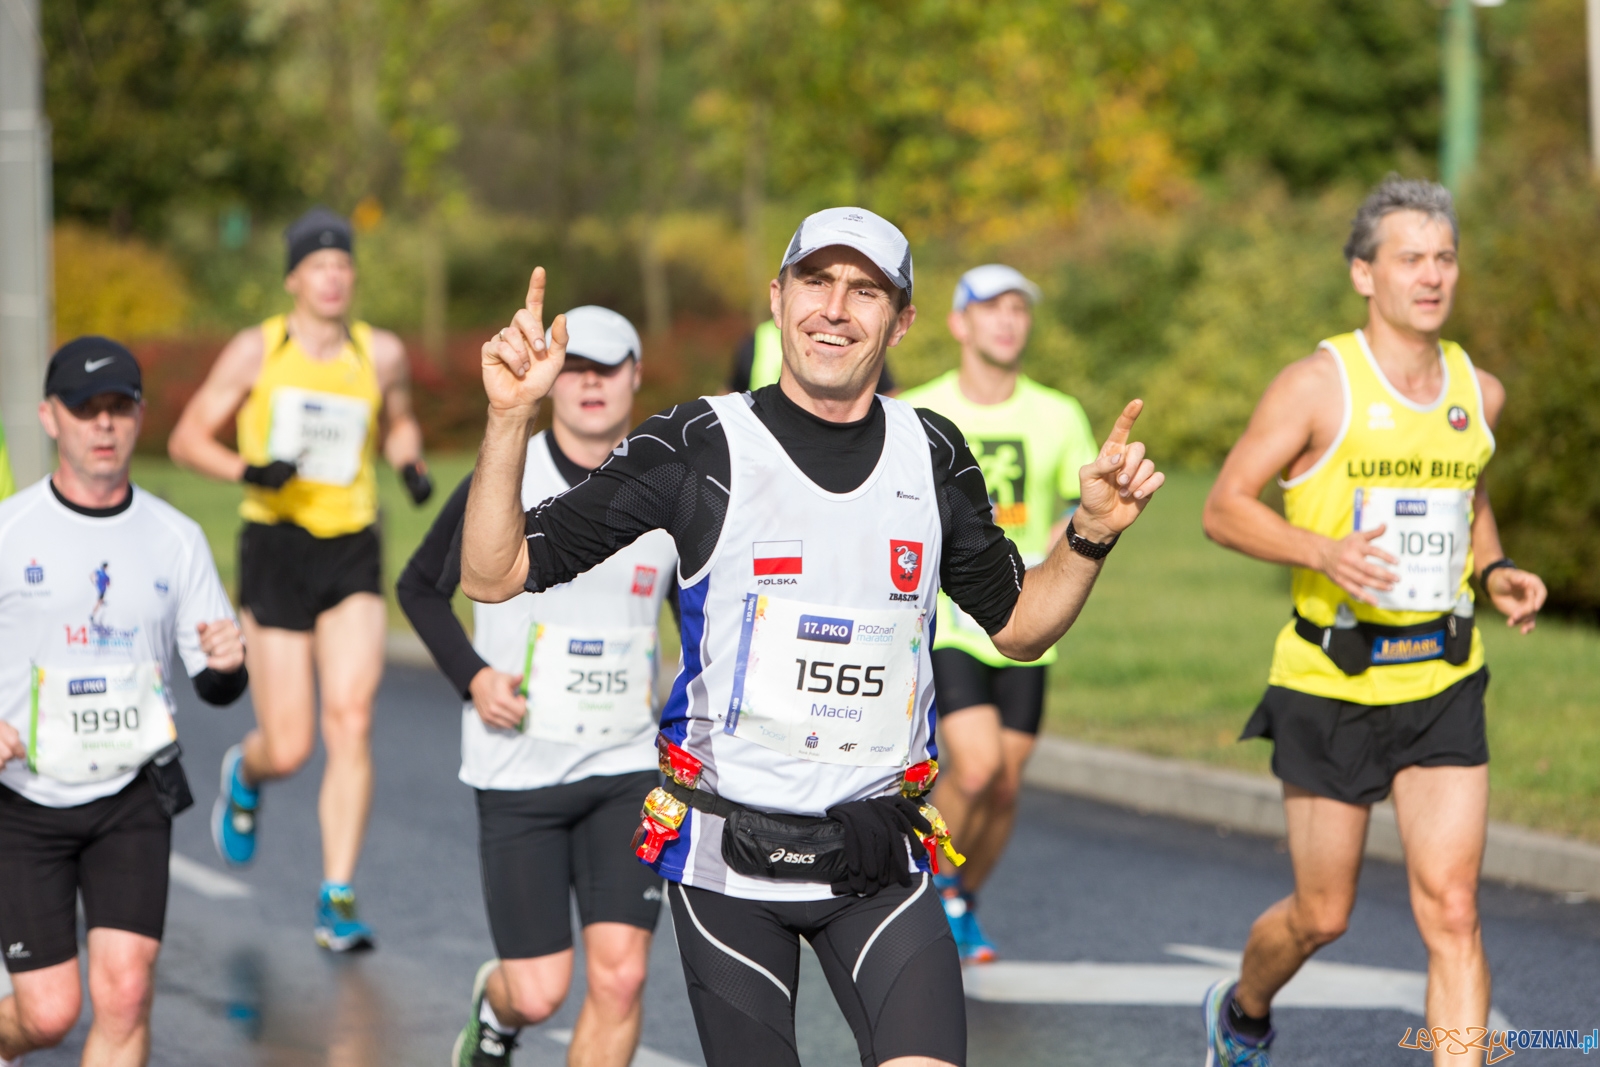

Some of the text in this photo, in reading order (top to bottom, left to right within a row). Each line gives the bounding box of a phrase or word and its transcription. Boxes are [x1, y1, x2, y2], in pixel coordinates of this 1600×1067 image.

[1430, 460, 1480, 481] BIEG
[1399, 531, 1454, 556] 1091
[757, 578, 798, 586] POLSKA
[856, 633, 893, 643] maraton
[566, 669, 628, 694] 2515
[796, 658, 886, 698] 1565
[71, 706, 139, 734] 1990
[810, 703, 864, 722] Maciej
[783, 852, 816, 864] asics
